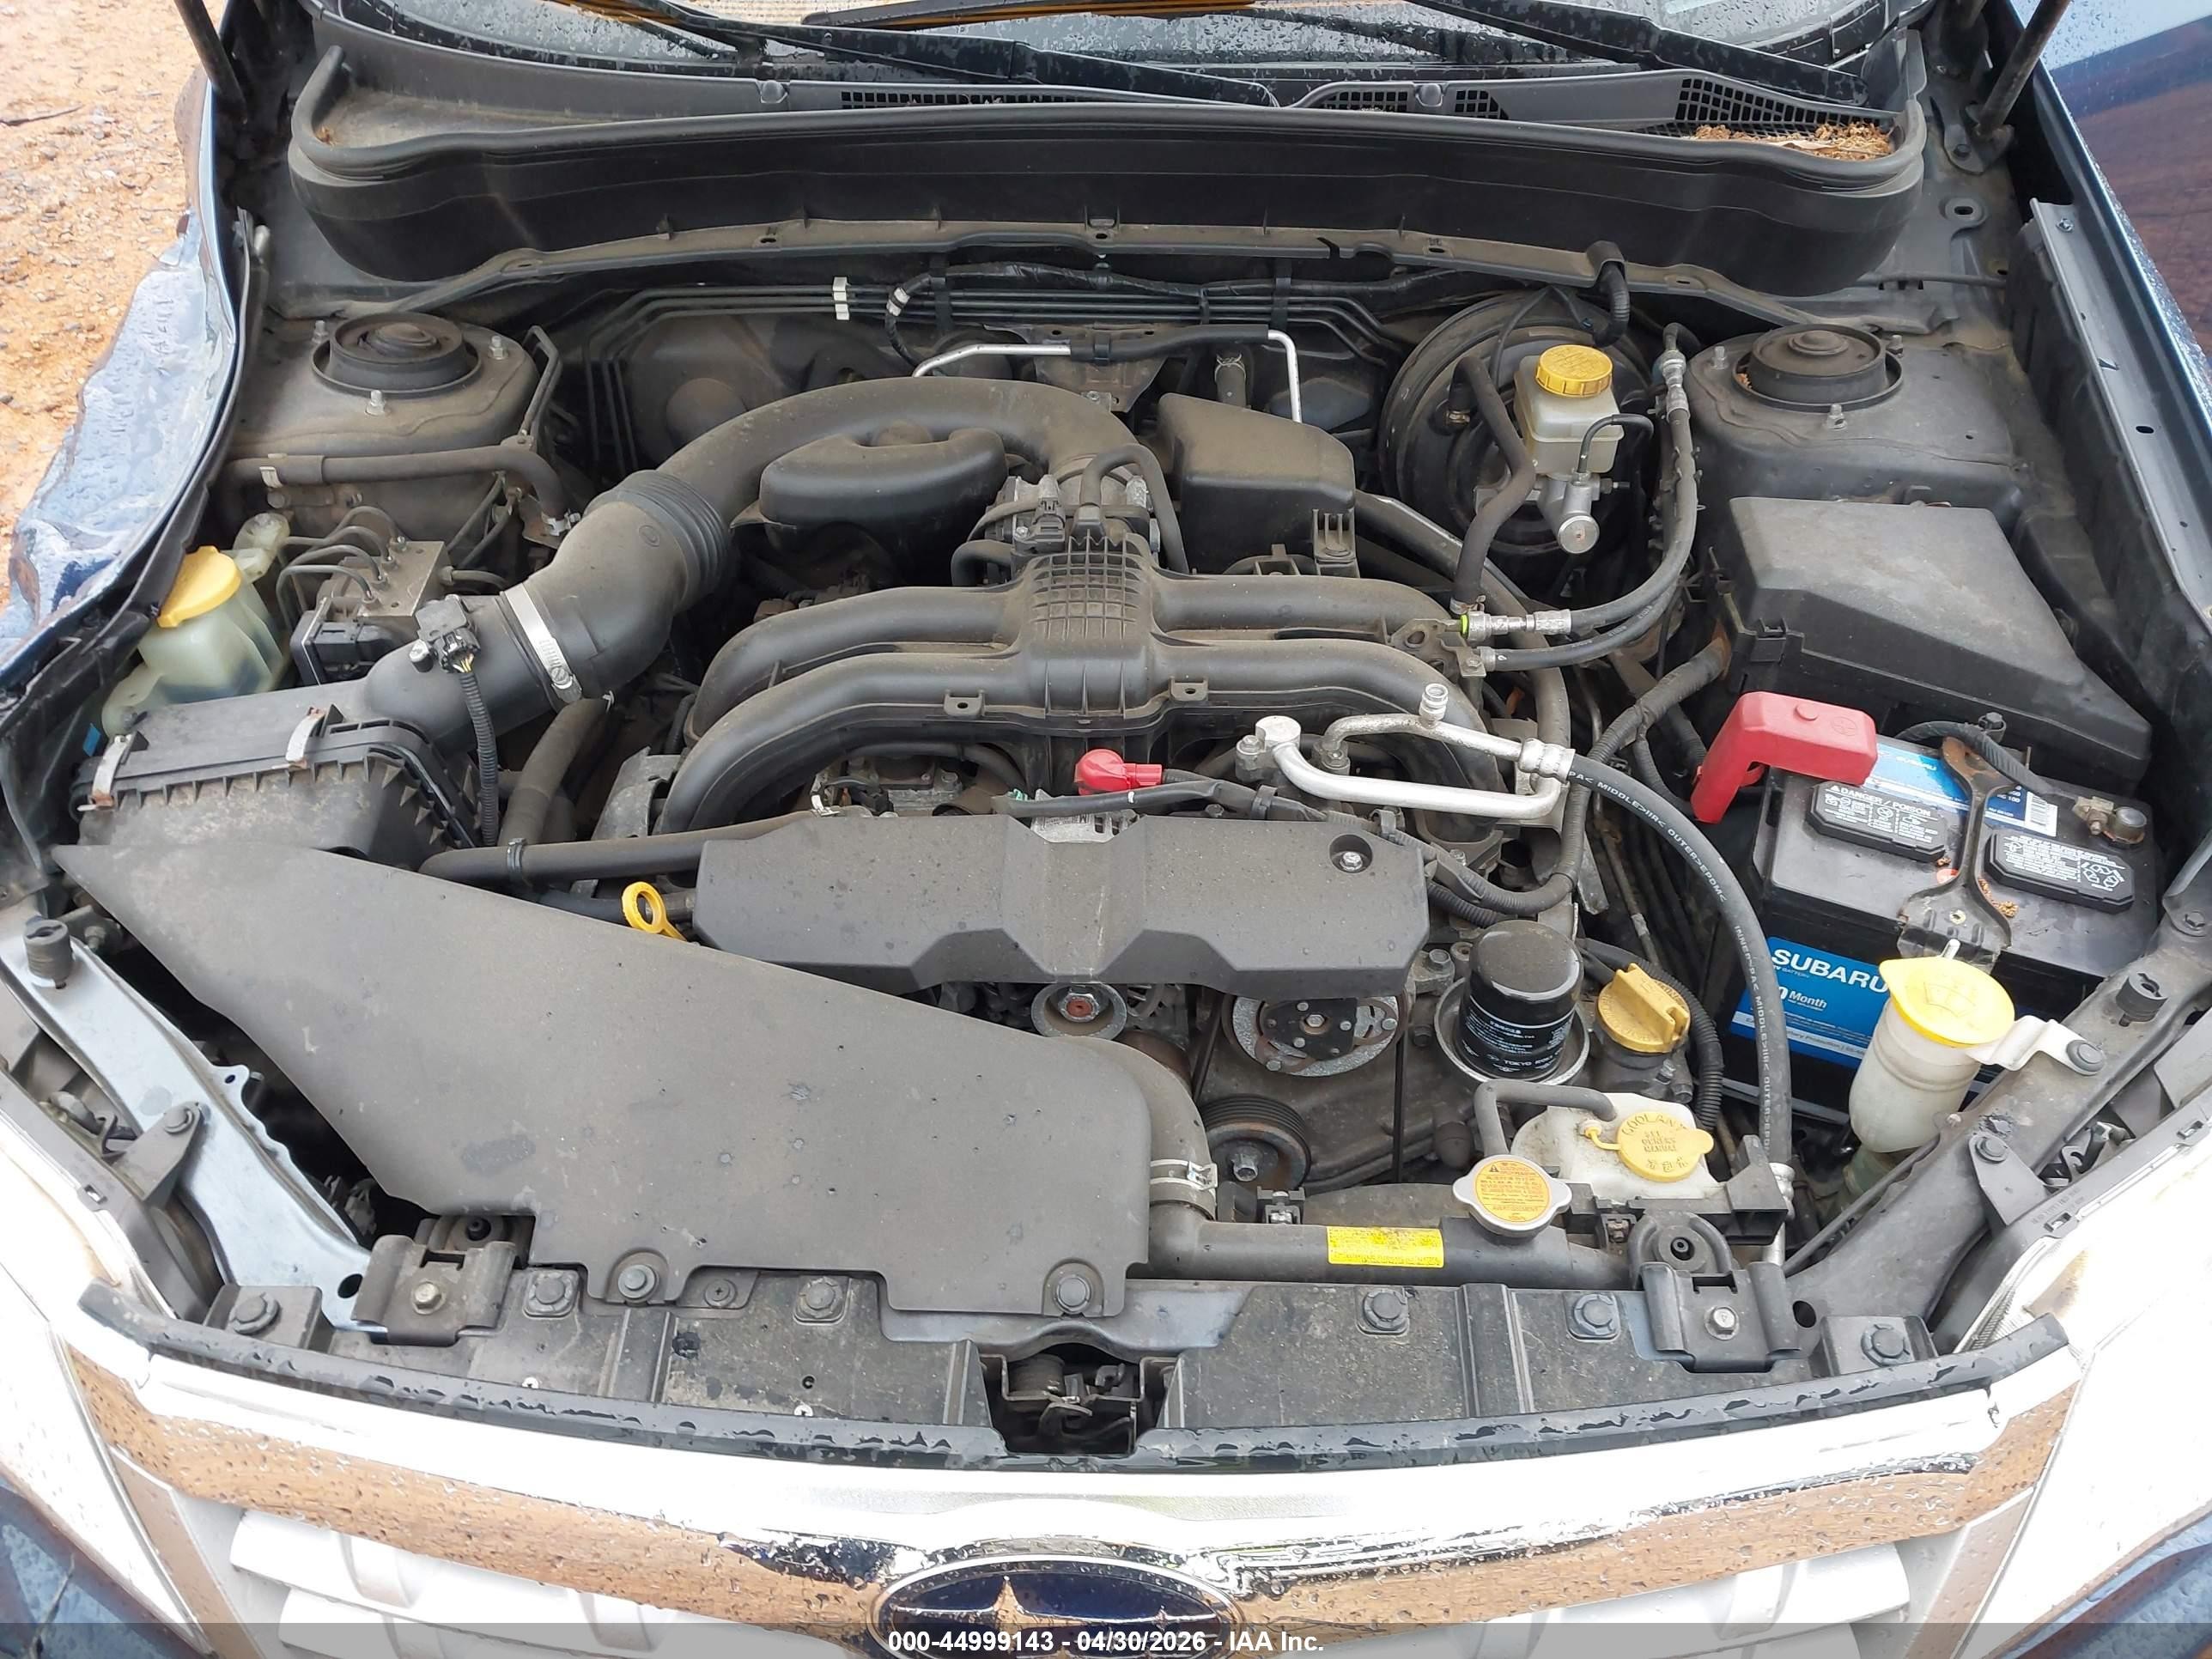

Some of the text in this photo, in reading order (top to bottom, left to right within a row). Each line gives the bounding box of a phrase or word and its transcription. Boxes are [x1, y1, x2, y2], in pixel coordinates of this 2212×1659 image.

[1841, 787, 1882, 805] DANGER
[1893, 802, 1931, 817] POISON
[1771, 949, 1888, 993] SUBARU
[1789, 991, 1827, 1008] Month
[1622, 1114, 1688, 1135] COOLANT
